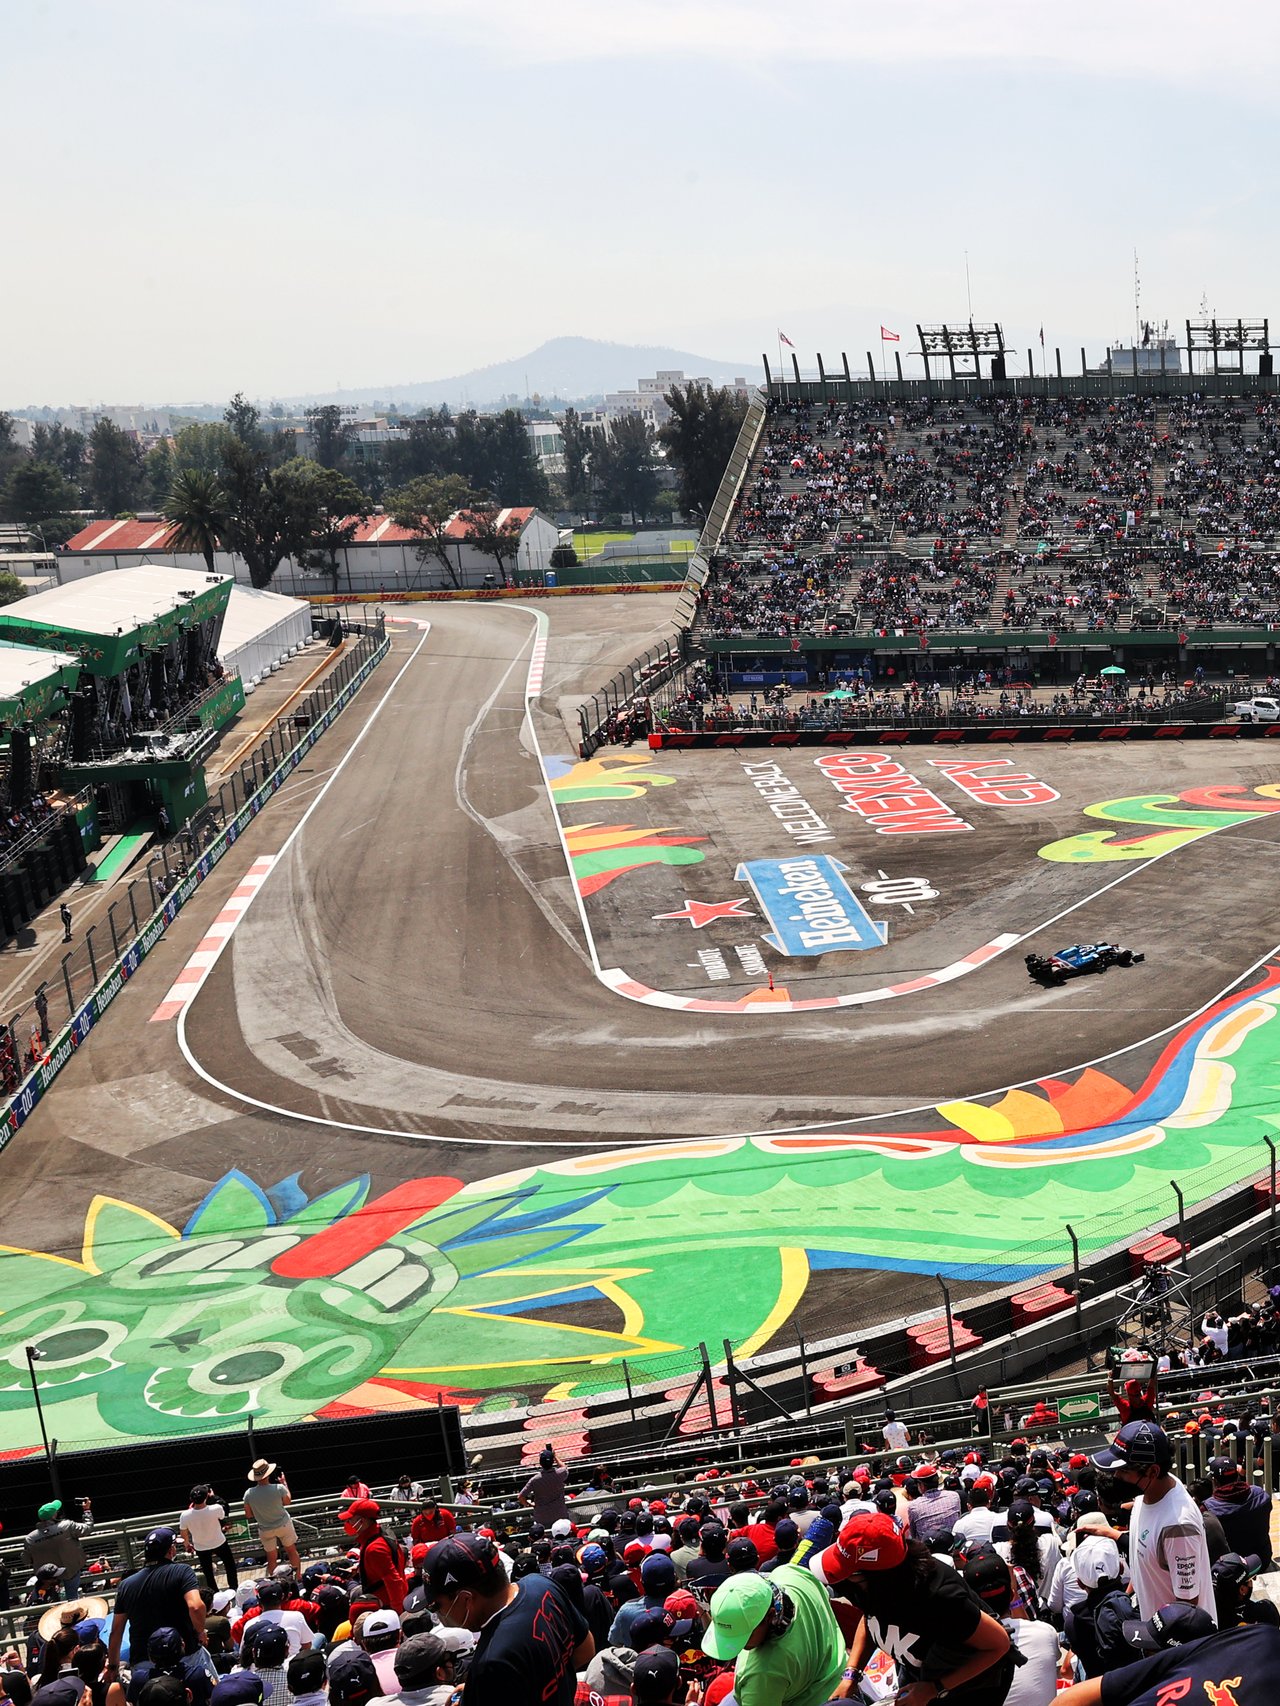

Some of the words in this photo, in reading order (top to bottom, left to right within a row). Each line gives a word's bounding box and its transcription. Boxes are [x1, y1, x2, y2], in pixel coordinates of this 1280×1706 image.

[333, 595, 360, 603] DHL
[380, 594, 407, 602] DHL
[427, 592, 454, 600] DHL
[475, 590, 501, 598] DHL
[522, 588, 549, 597] DHL
[569, 587, 596, 595] DHL
[616, 585, 642, 594] DHL
[740, 759, 789, 790] BACK
[926, 758, 1062, 807] CITY
[813, 752, 976, 835] MÉXICO
[756, 786, 836, 846] WELCOME
[777, 859, 863, 949] Heineken
[142, 917, 164, 953] Heineken
[97, 973, 123, 1013] Heineken
[41, 1043, 72, 1083] Heineken
[1176, 1562, 1196, 1570] EPSON
